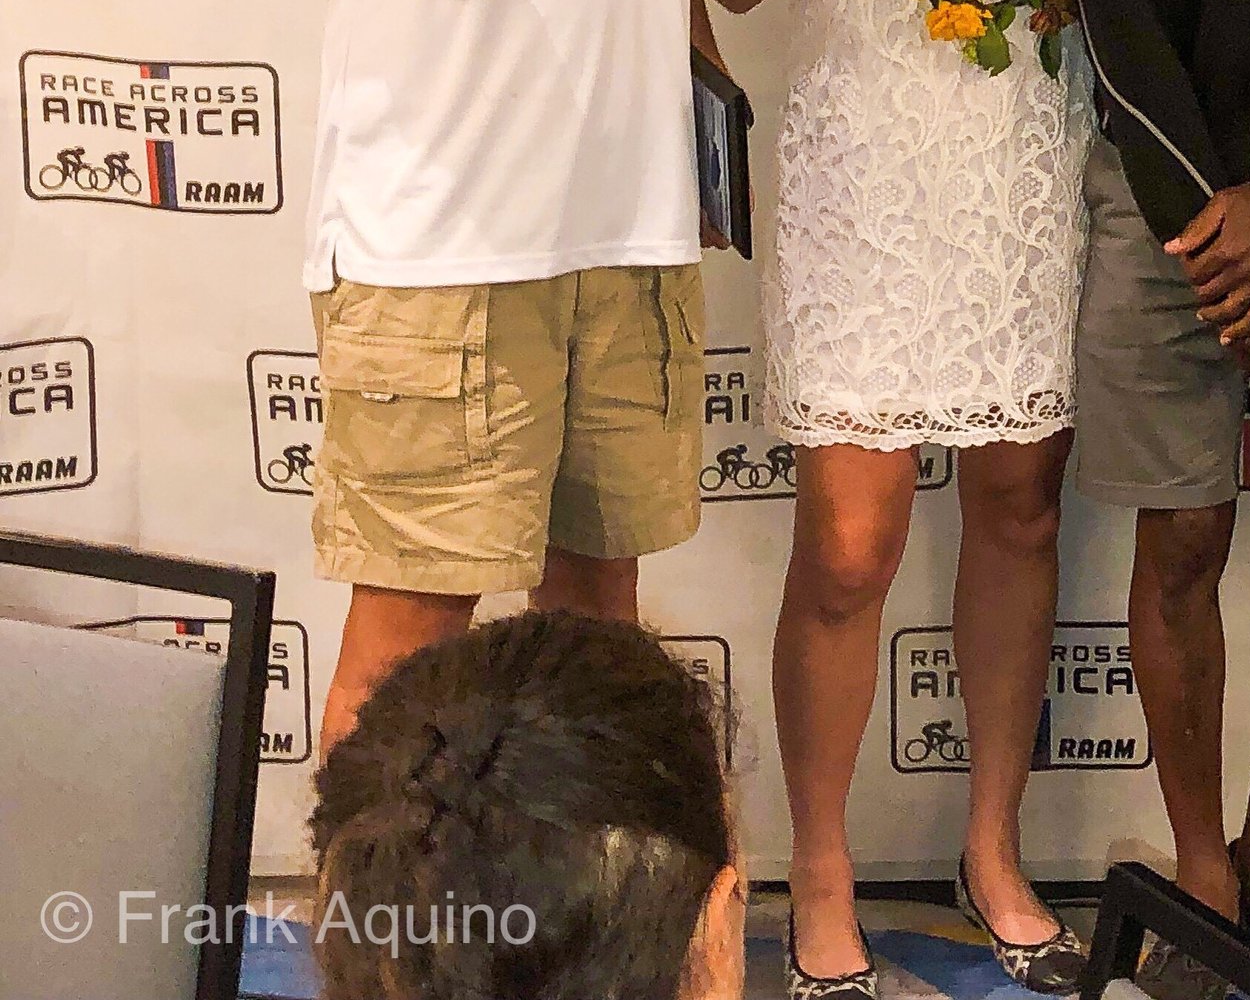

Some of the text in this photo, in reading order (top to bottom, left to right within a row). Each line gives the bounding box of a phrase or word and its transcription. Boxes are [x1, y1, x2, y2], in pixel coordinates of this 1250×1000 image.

[41, 75, 258, 104] RACE ACROSS
[43, 96, 259, 136] AMERICA
[185, 181, 264, 203] RAAM
[268, 374, 320, 393] RAC
[705, 372, 744, 392] RA
[1050, 643, 1133, 664] ROSS
[1057, 738, 1135, 759] RAAM
